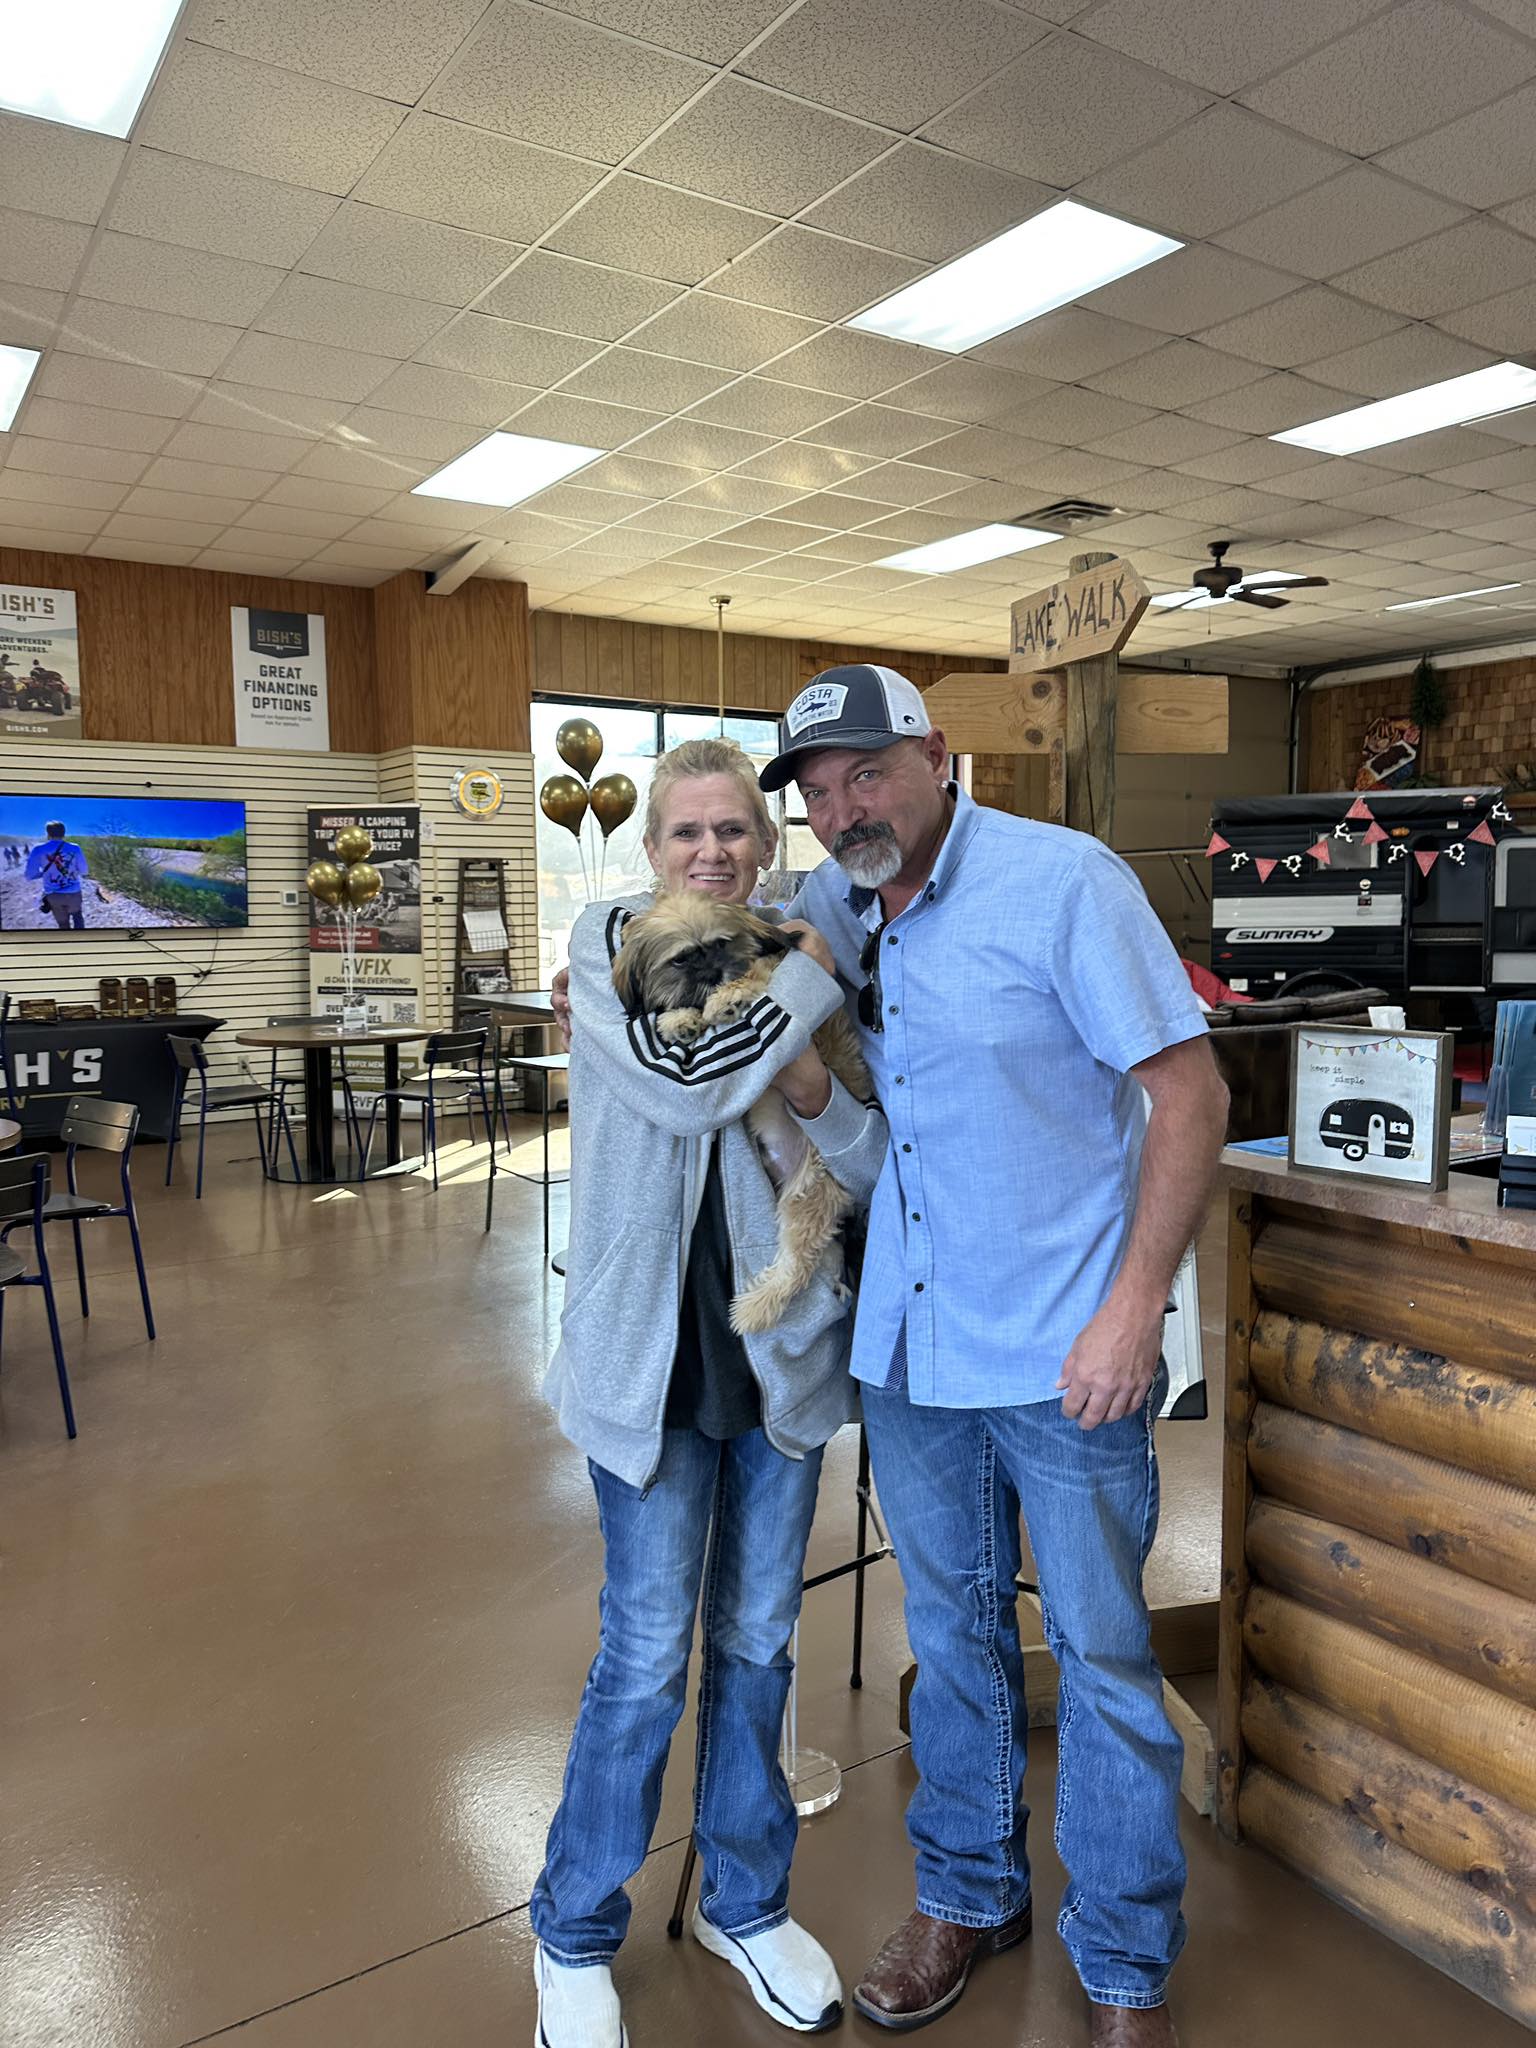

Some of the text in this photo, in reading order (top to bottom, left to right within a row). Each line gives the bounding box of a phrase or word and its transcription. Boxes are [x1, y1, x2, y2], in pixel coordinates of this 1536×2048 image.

[1012, 573, 1126, 655] LAKE WALK
[16, 636, 53, 647] WEEKEND
[256, 629, 303, 645] BISH'S
[259, 664, 302, 680] GREAT
[243, 679, 319, 697] FINANCING
[251, 696, 312, 713] OPTIONS
[795, 688, 833, 712] COSTA
[322, 816, 407, 827] MISSED A CAMPING
[314, 829, 335, 839] TRIP
[377, 829, 400, 839] YOUR
[402, 829, 415, 839] RV
[1236, 929, 1323, 940] SUNRAY
[367, 976, 411, 985] EVERYTHING!
[0, 1048, 104, 1088] H'S
[1309, 1064, 1330, 1074] keep
[1334, 1076, 1366, 1086] simple
